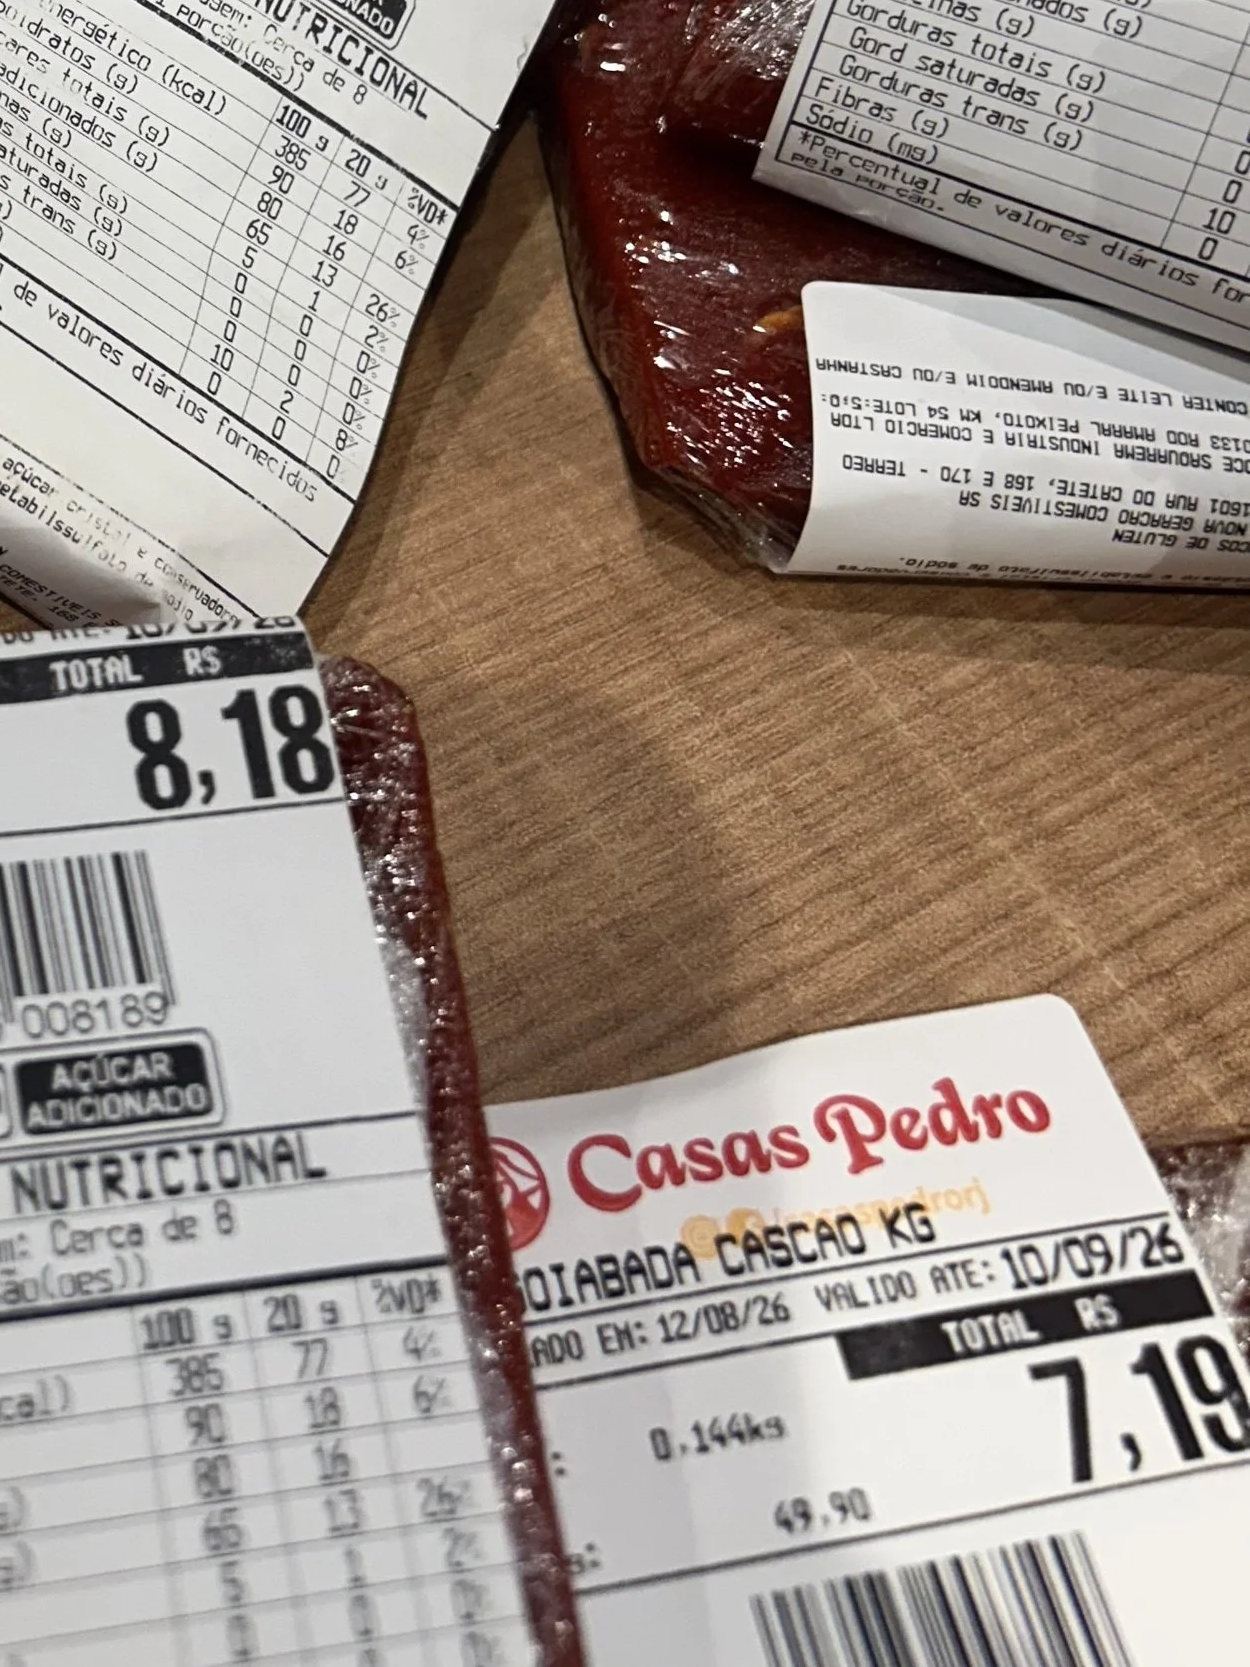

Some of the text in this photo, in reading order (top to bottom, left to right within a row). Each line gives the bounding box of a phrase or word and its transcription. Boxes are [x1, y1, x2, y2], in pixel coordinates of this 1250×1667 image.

[849, 25, 1041, 107] Gord saturadas
[161, 63, 372, 208] (kcal) 385 77
[275, 104, 372, 179] 100 20
[805, 103, 874, 149] Sódio
[25, 132, 88, 189] totais
[48, 303, 124, 367] valores
[131, 361, 208, 425] diários
[815, 358, 1173, 407] LEITE AMENDOIM CASTANHA
[830, 412, 1100, 456] INDUSTRIA COMERCIO LTDA
[994, 412, 1156, 443] AMARAL PEIXOTO,
[842, 454, 1199, 513] RUA DO CATETE, 168 170 TERREO
[958, 490, 1195, 533] GERACAO COMESTIVEIS SA
[1111, 528, 1179, 549] GLUTEN
[49, 648, 223, 694] TOTAL R$
[125, 683, 335, 812] 8,18
[20, 984, 171, 1041] 008189
[51, 1051, 172, 1093] AÇÚCAR
[26, 1083, 212, 1136] ADICIONADO
[10, 1134, 328, 1214] NUTRICIONAL
[567, 1125, 810, 1214] Casas
[813, 1077, 1051, 1175] Pedro
[713, 1213, 867, 1277] CASCAO
[882, 1201, 936, 1248] KG
[596, 1321, 648, 1356] EM:
[657, 1293, 791, 1345] 12/08/26
[814, 1270, 918, 1312] VALIDO
[929, 1258, 996, 1294] ATE:
[1000, 1221, 1185, 1291] 10/09/26
[941, 1294, 1118, 1353] TOTAL R$
[1028, 1333, 1250, 1484] 7,19
[773, 1488, 871, 1536] 49,90
